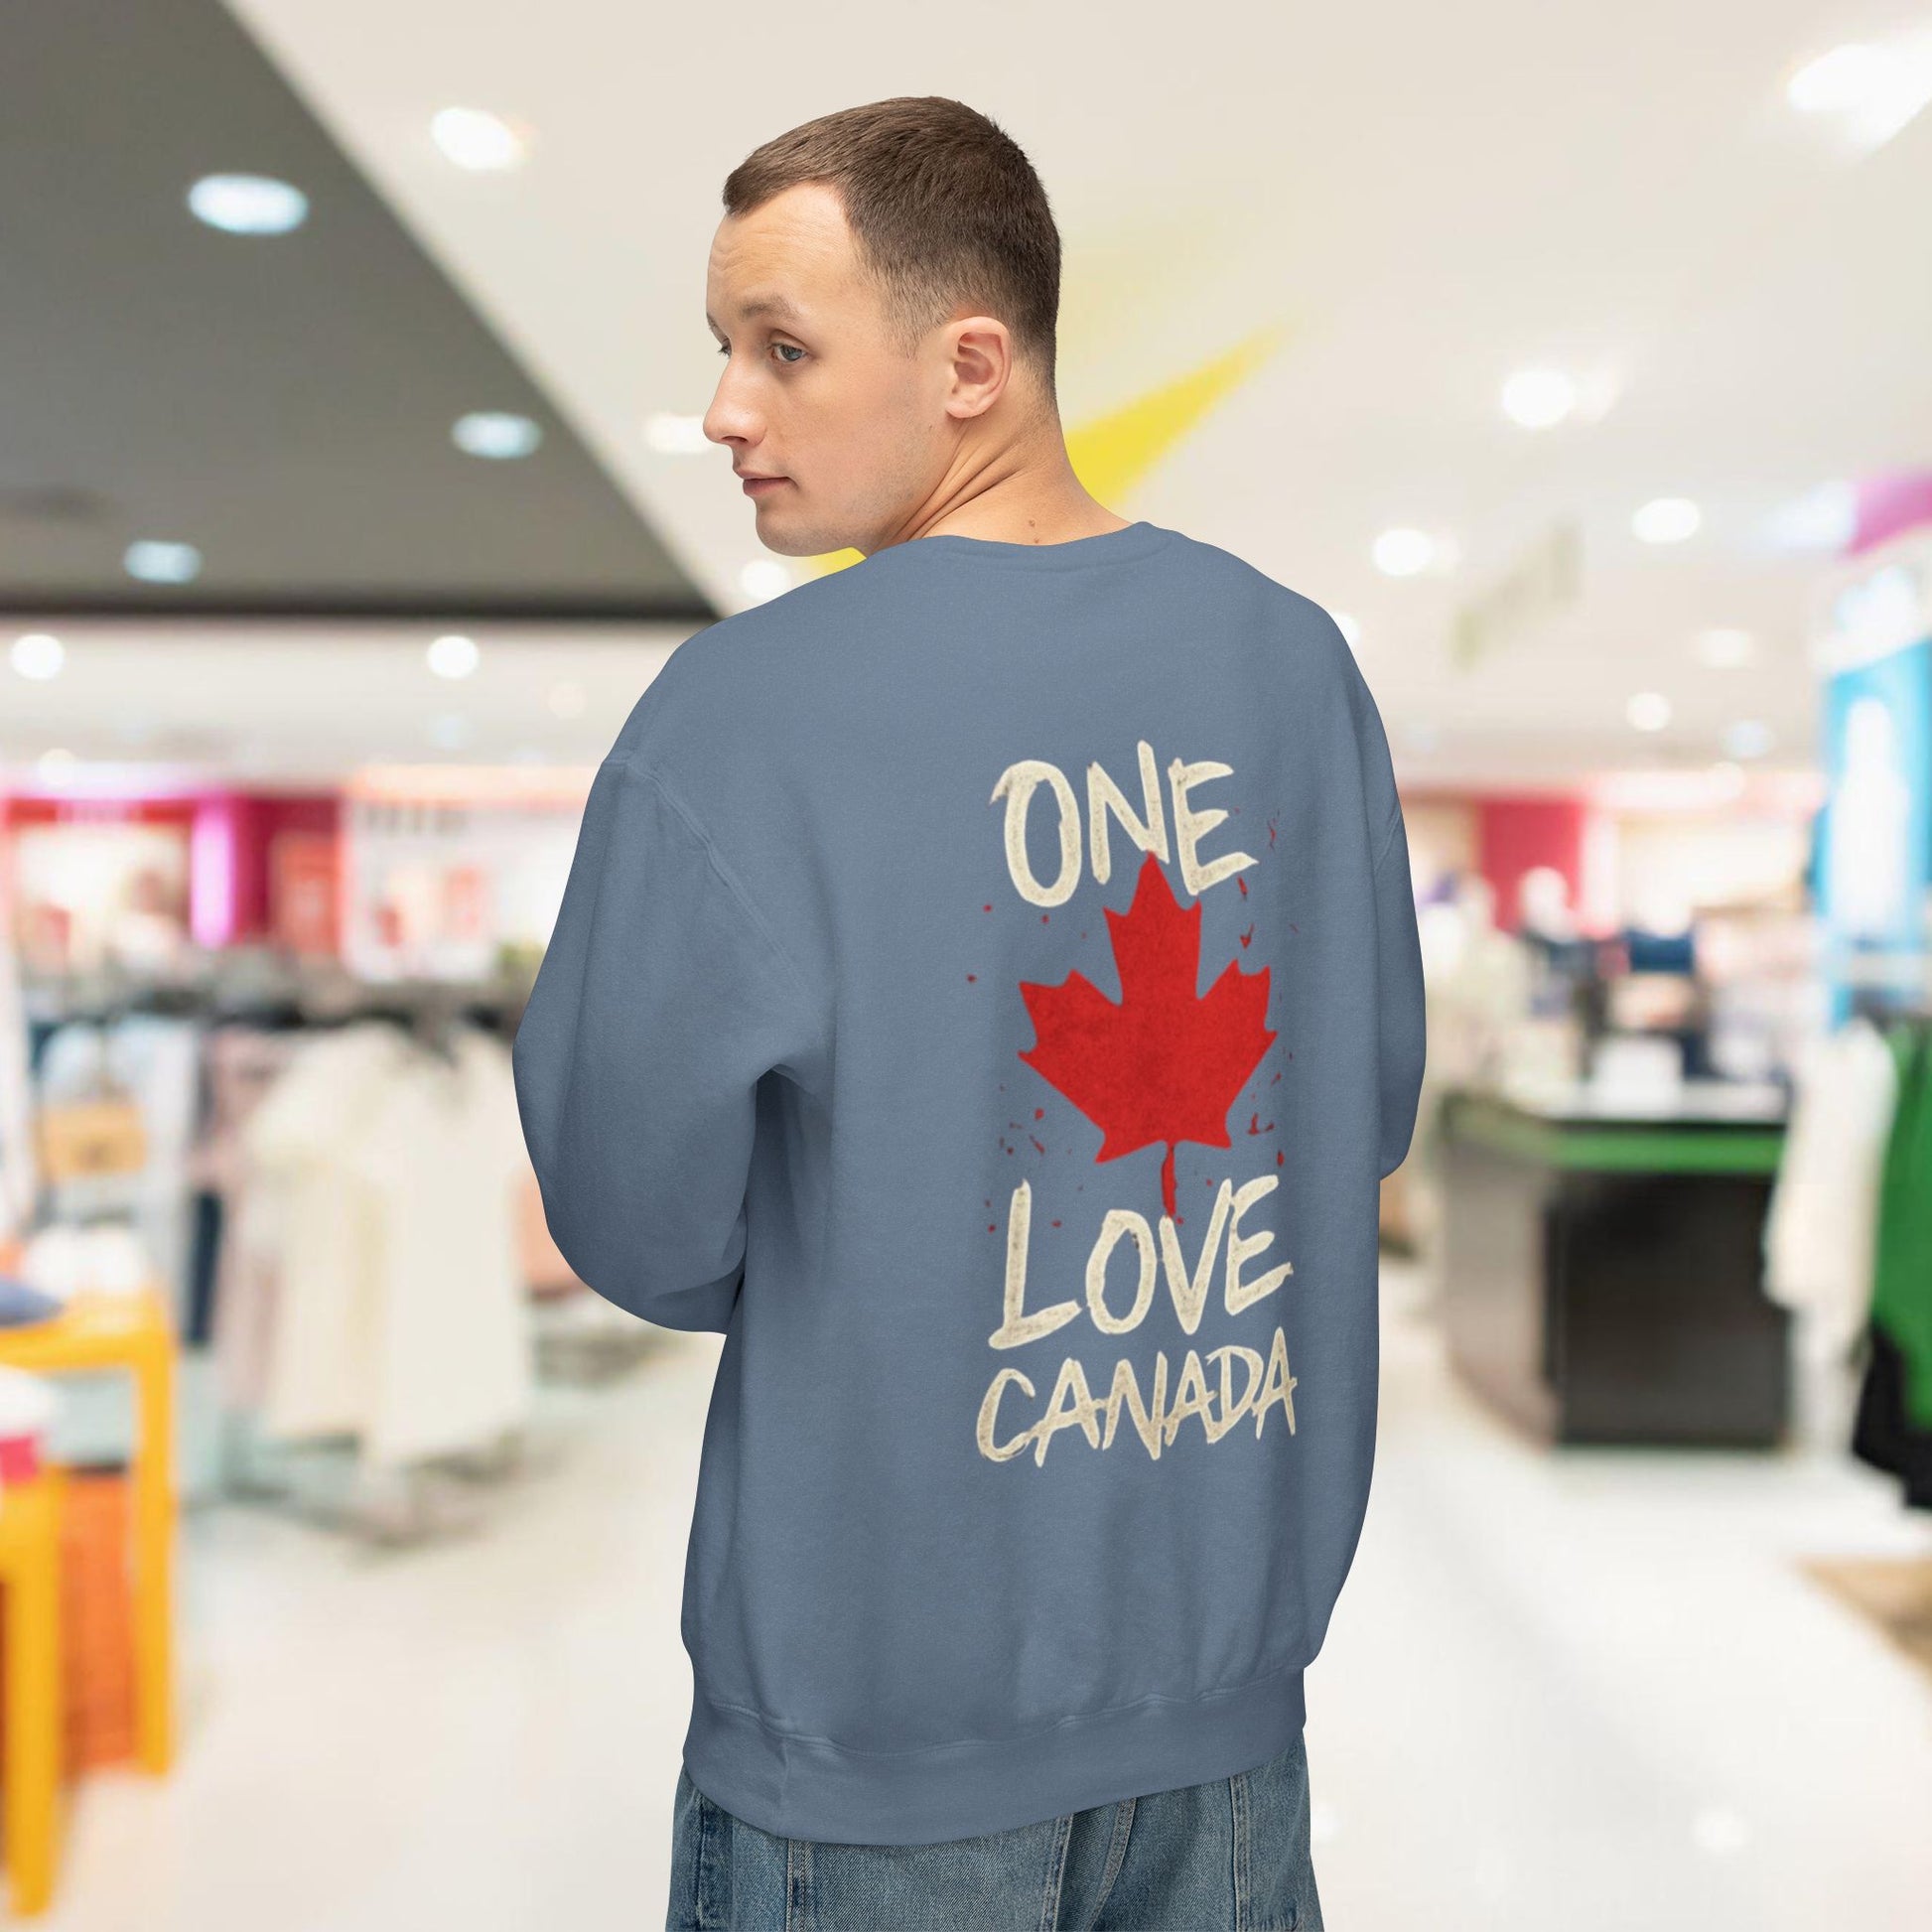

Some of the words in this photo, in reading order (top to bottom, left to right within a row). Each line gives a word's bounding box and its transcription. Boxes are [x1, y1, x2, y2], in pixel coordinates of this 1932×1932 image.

[990, 740, 1259, 907] ONE
[988, 1174, 1294, 1350] LOVE
[976, 1326, 1298, 1467] CANADA
